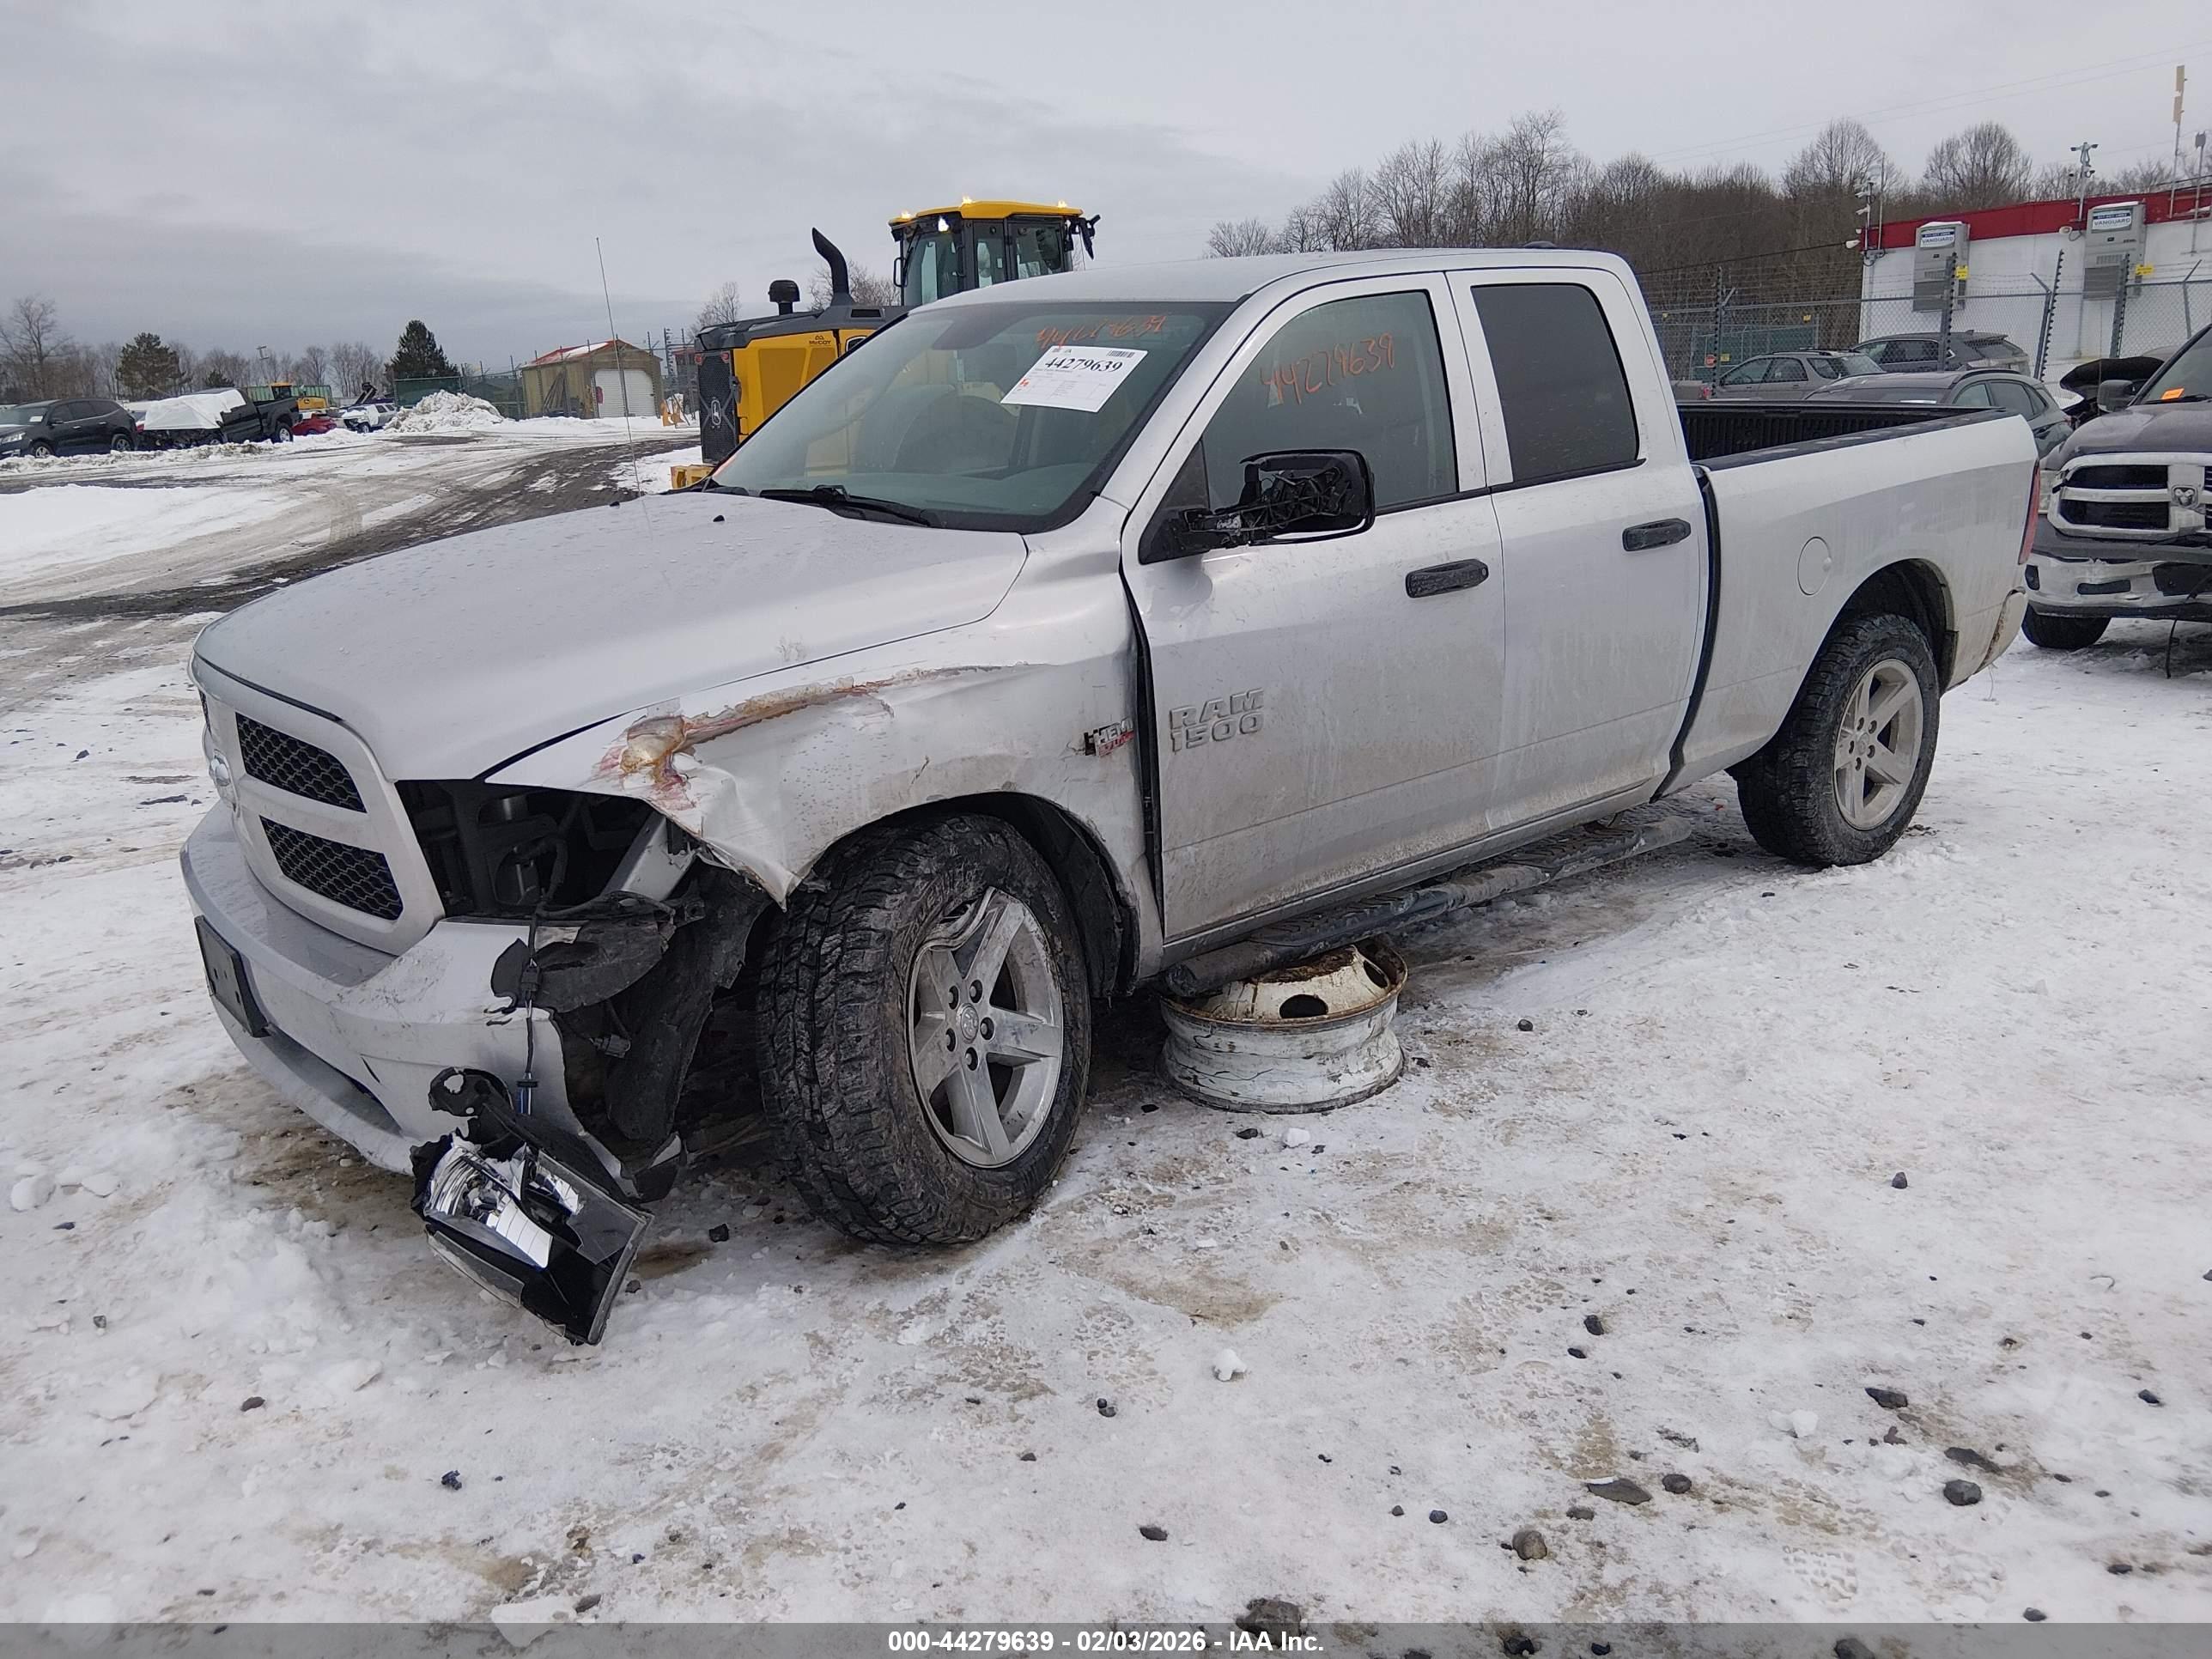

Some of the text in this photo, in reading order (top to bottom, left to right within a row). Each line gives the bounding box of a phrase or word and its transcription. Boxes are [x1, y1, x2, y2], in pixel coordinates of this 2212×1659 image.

[2093, 216, 2131, 226] VANGUARD
[1045, 352, 1124, 373] 44279639
[1260, 332, 1395, 405] 44279639
[1169, 687, 1265, 727] RAM
[1170, 711, 1264, 752] 1500
